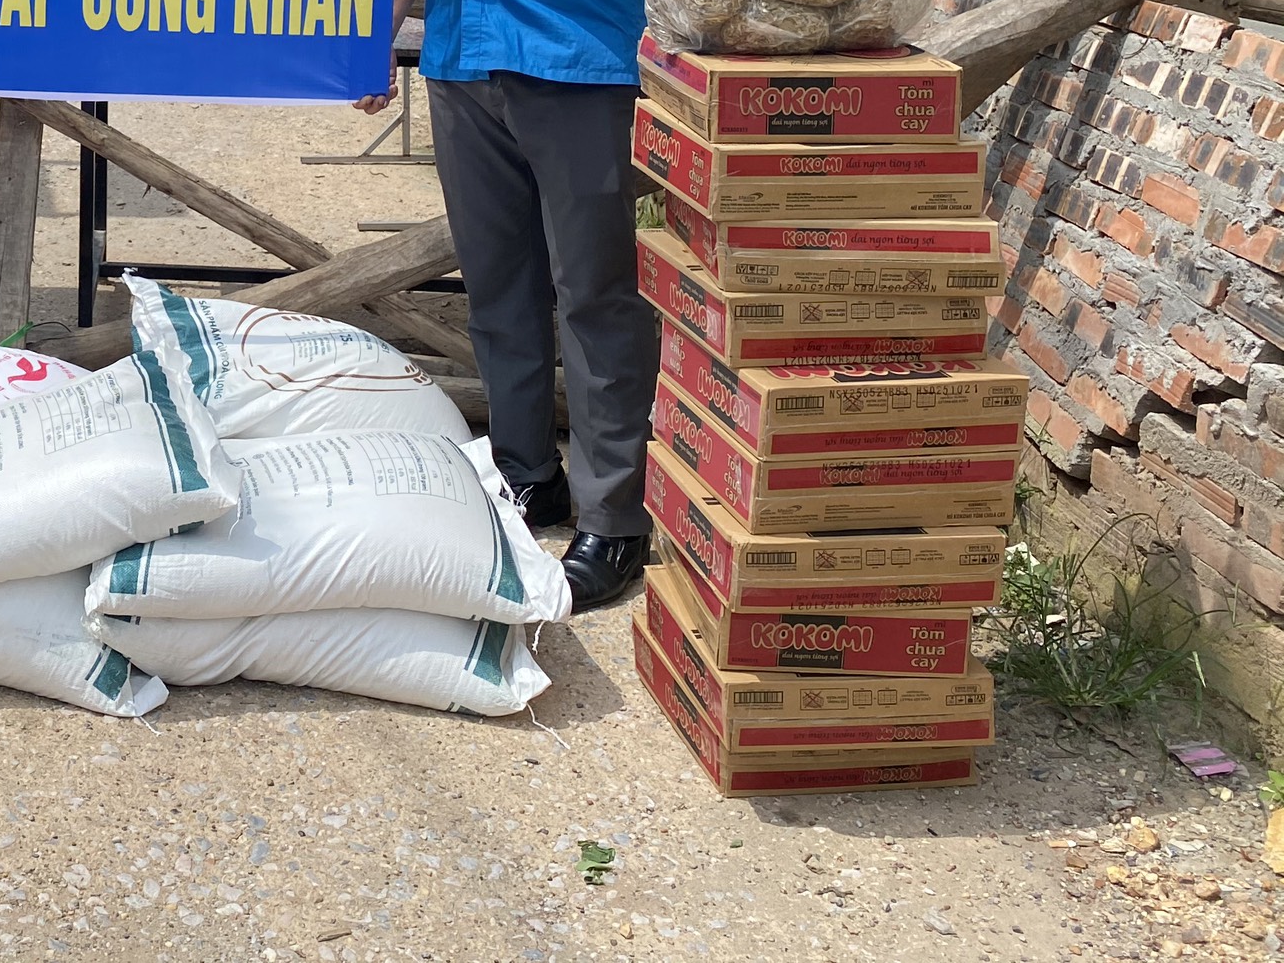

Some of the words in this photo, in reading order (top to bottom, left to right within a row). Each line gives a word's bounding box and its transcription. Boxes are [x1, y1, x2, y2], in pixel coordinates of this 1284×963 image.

[898, 85, 934, 100] Tôm
[739, 87, 863, 117] KOKOMI
[895, 102, 936, 117] chua
[900, 117, 930, 133] cay
[641, 119, 682, 168] KOKOMI
[780, 157, 843, 173] KOKOMI
[783, 230, 848, 248] KOKOMI
[873, 338, 935, 354] KOKOMI
[664, 398, 714, 464] KOKOMI
[906, 429, 967, 446] KOKOMI
[819, 467, 881, 485] KOKOMI
[751, 622, 874, 652] KOKOMI
[909, 626, 945, 640] Tôm
[906, 642, 946, 656] chua
[910, 656, 939, 671] cay
